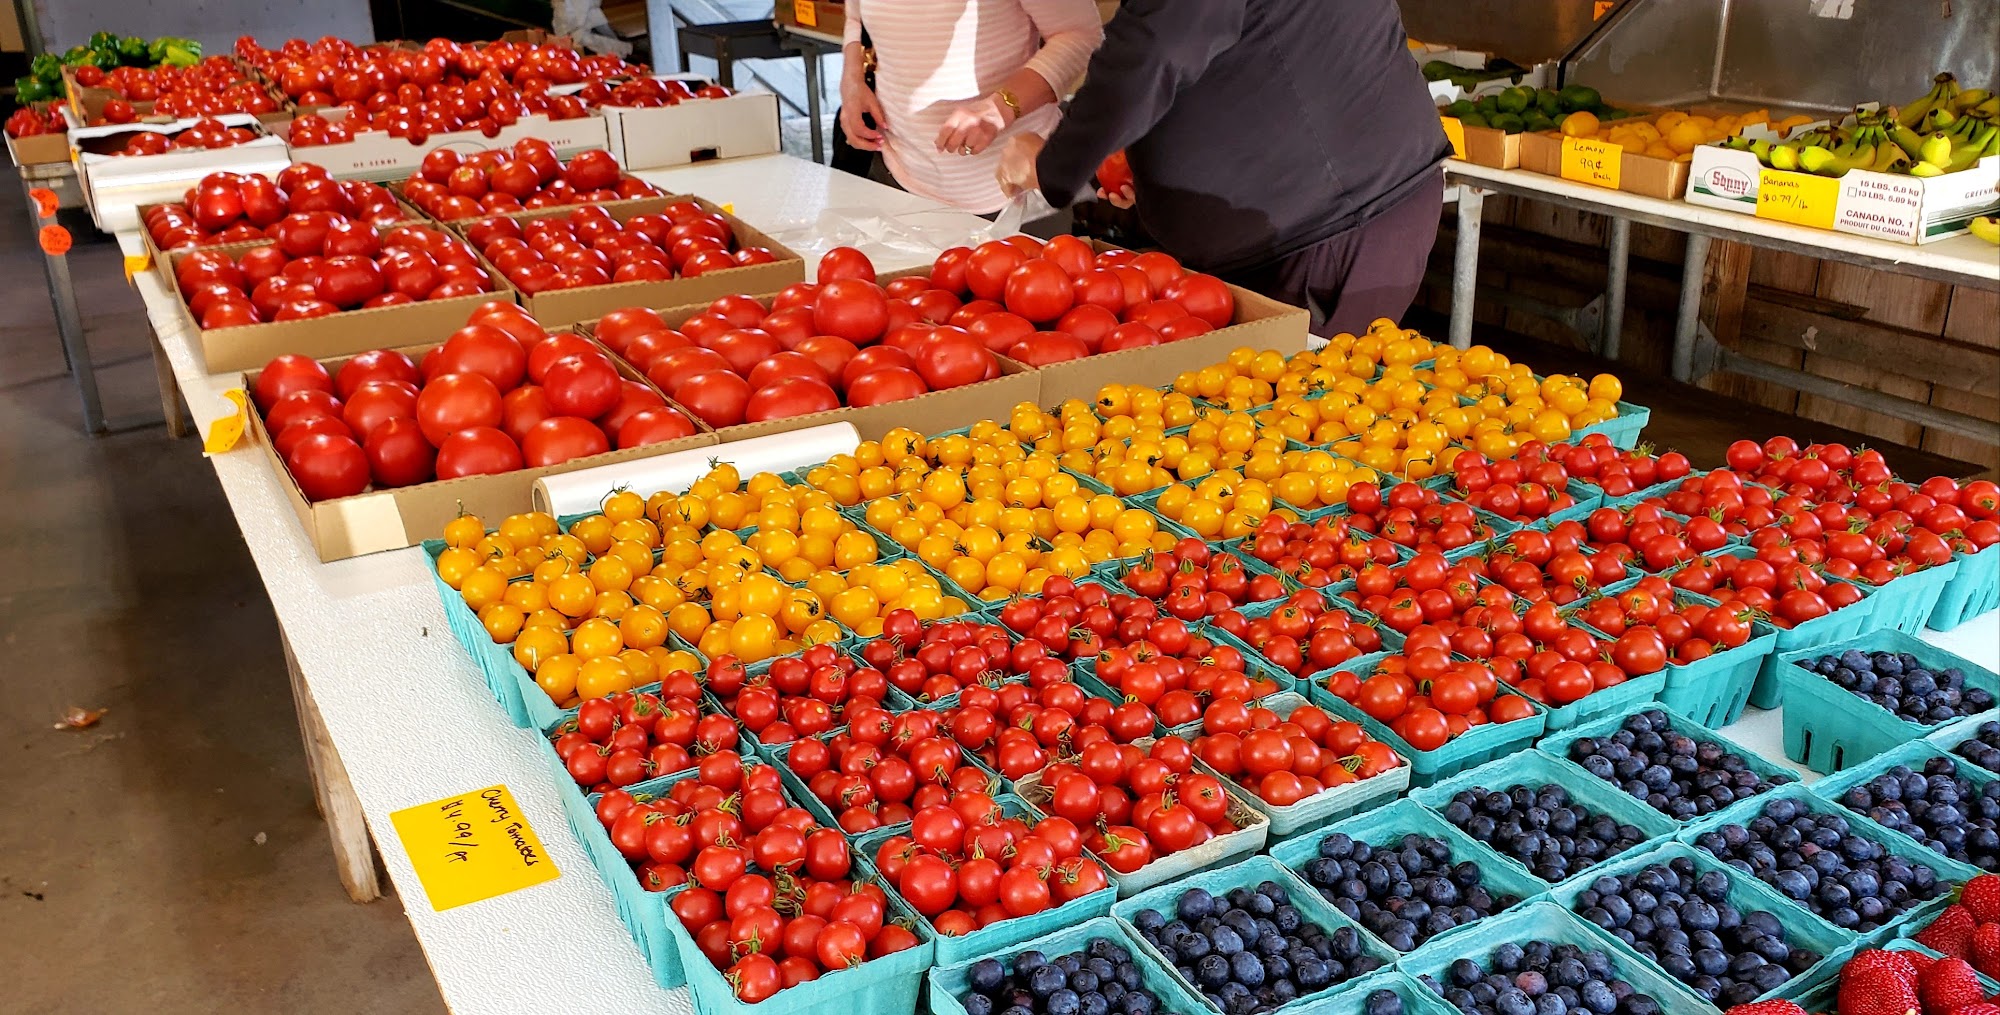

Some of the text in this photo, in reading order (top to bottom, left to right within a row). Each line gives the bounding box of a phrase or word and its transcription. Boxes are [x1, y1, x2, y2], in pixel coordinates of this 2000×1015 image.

[1763, 175, 1800, 188] Bananas
[1840, 218, 1910, 237] PRODUIT DU CANADA
[1846, 209, 1886, 224] CANADA
[1887, 217, 1905, 228] NO.
